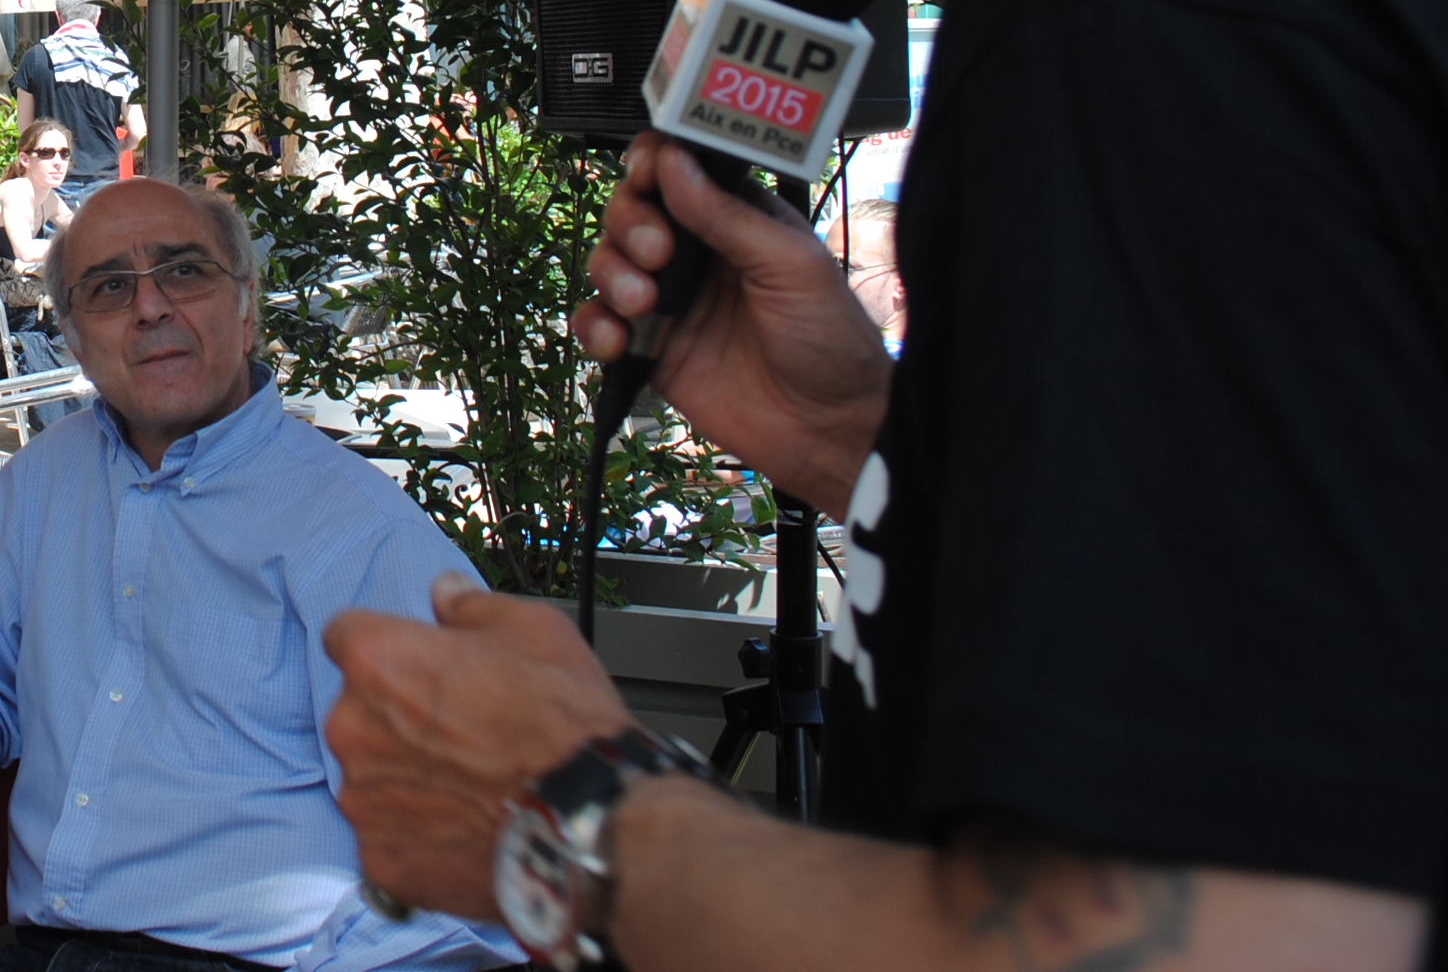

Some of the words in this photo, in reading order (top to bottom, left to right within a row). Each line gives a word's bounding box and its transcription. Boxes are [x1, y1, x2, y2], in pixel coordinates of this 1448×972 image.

[718, 16, 838, 80] JILP
[689, 102, 725, 127] Aix
[729, 119, 758, 140] en
[710, 66, 808, 126] 2015
